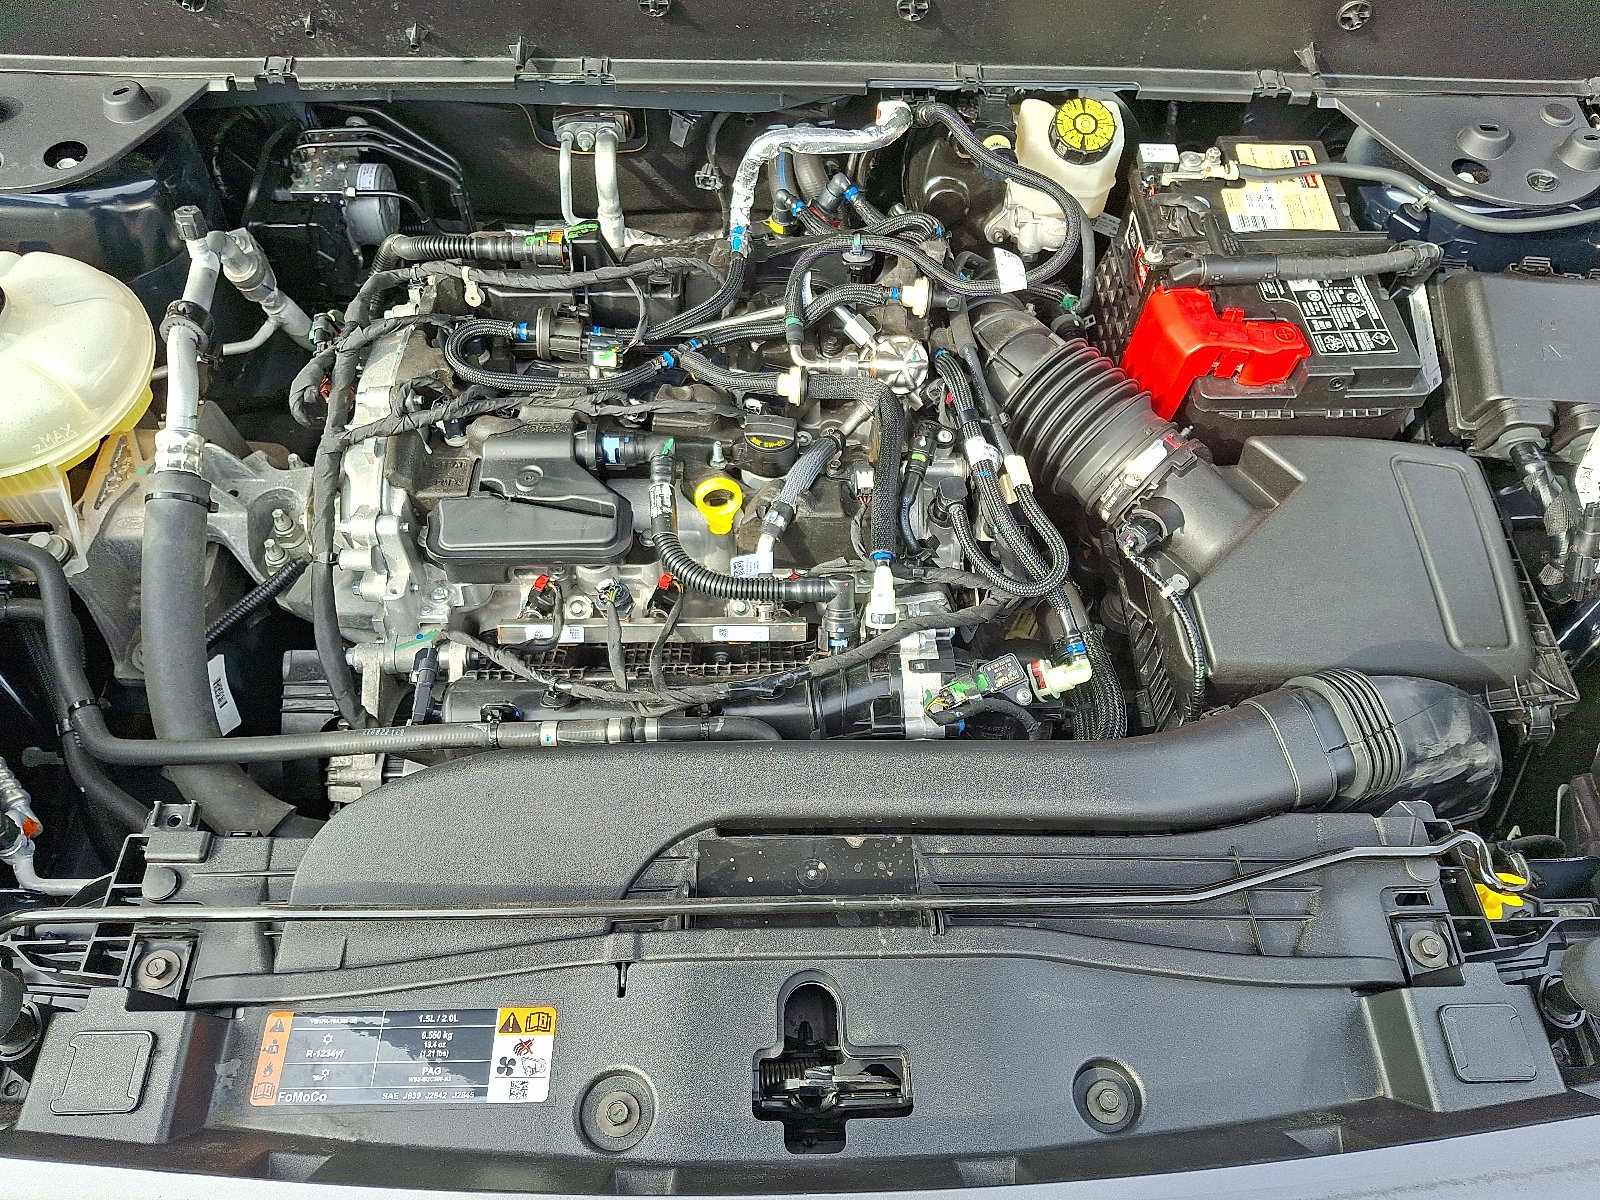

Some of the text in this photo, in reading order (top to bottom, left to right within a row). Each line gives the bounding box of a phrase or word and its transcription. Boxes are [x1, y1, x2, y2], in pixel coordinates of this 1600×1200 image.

[38, 423, 78, 447] MAX
[418, 1014, 436, 1023] 1.5L
[441, 1013, 460, 1023] 2.0L
[421, 1031, 454, 1041] 0.550 kg
[305, 1049, 345, 1059] R-1234yf
[421, 1066, 442, 1076] PAG
[277, 1091, 327, 1103] FoMoCo
[382, 1091, 475, 1101] SAE J639 J2842 J2845
